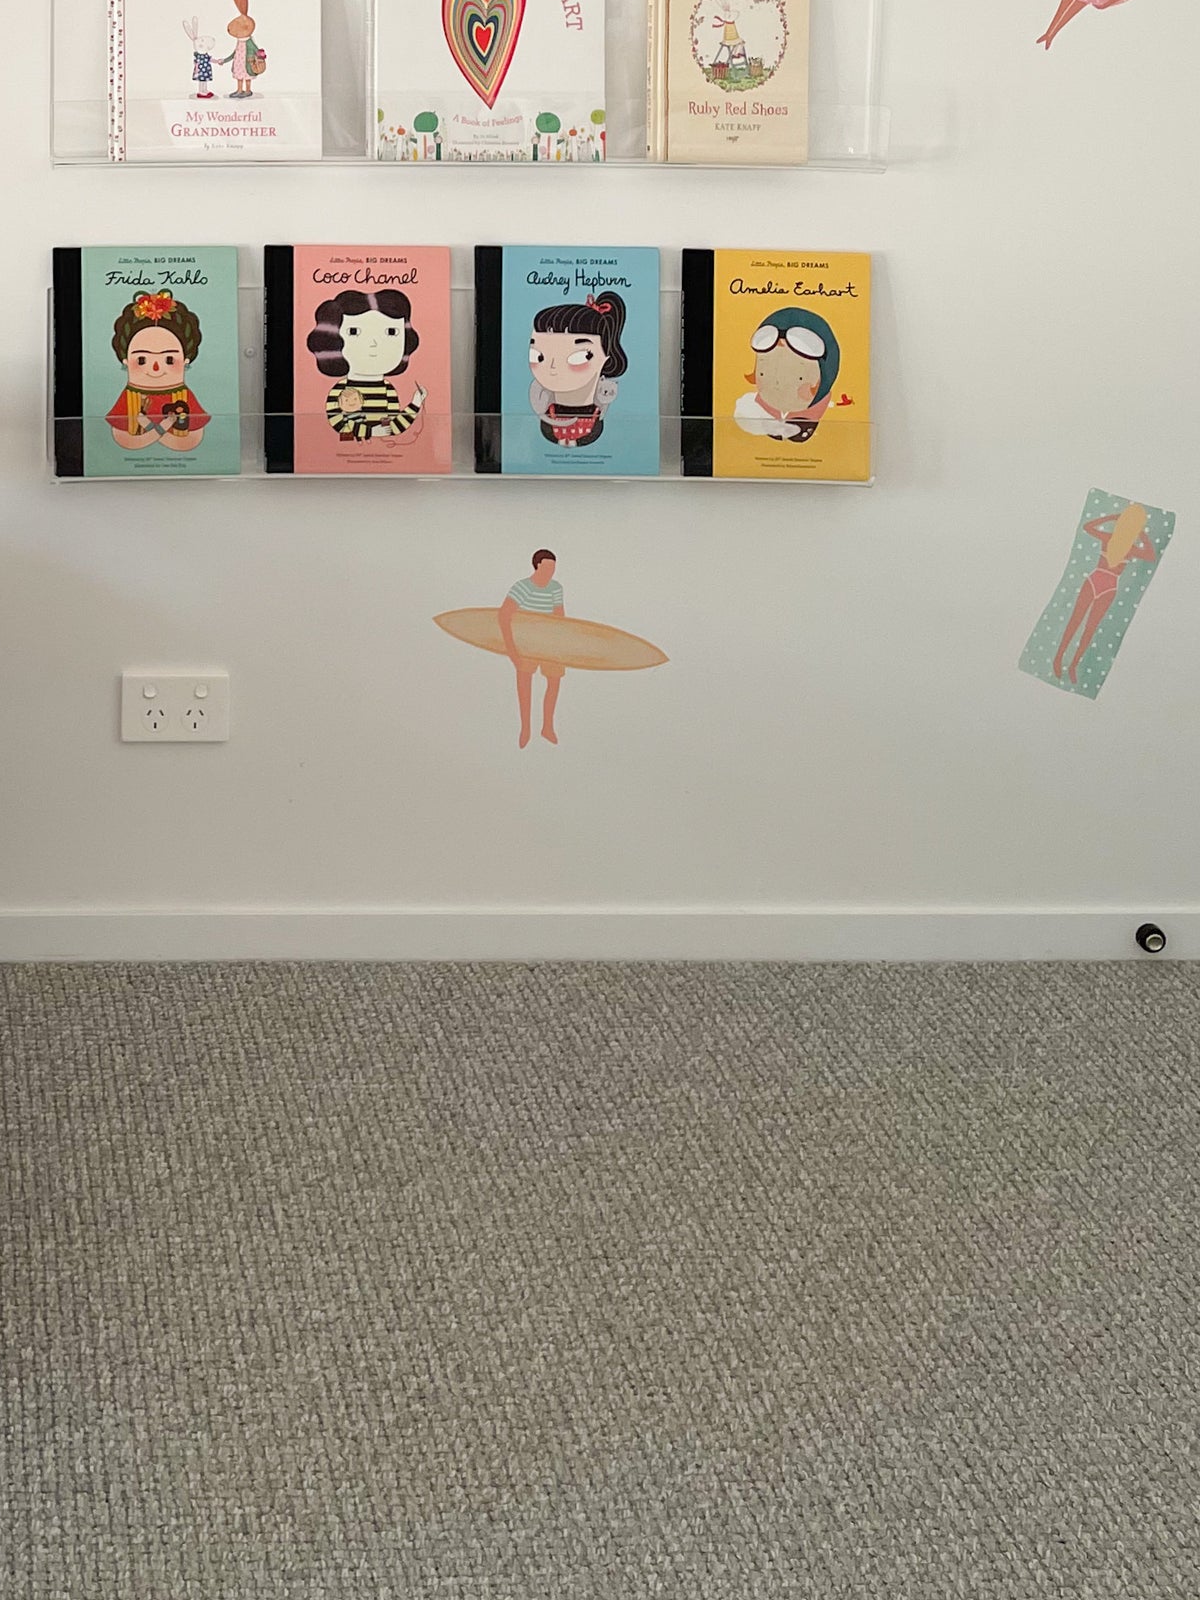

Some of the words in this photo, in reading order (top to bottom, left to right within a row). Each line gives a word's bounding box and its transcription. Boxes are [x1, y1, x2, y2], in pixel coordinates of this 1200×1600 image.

[186, 111, 204, 124] My
[206, 111, 262, 122] Wonderful
[688, 101, 720, 118] Ruby
[725, 101, 747, 116] Red
[751, 101, 788, 116] Shoes
[452, 114, 459, 123] A
[461, 116, 480, 127] Book
[482, 118, 490, 127] of
[492, 115, 523, 127] Feelings
[715, 123, 734, 131] KATE
[171, 123, 277, 137] GRANDMOTHER
[105, 269, 155, 286] Frida
[157, 269, 209, 285] Kahlo
[312, 268, 352, 284] Coco
[354, 267, 419, 285] Chanel
[526, 270, 570, 295] Audrey
[575, 267, 632, 293] Hepburn
[729, 278, 789, 294] Amelia
[793, 281, 859, 298] Earhart
